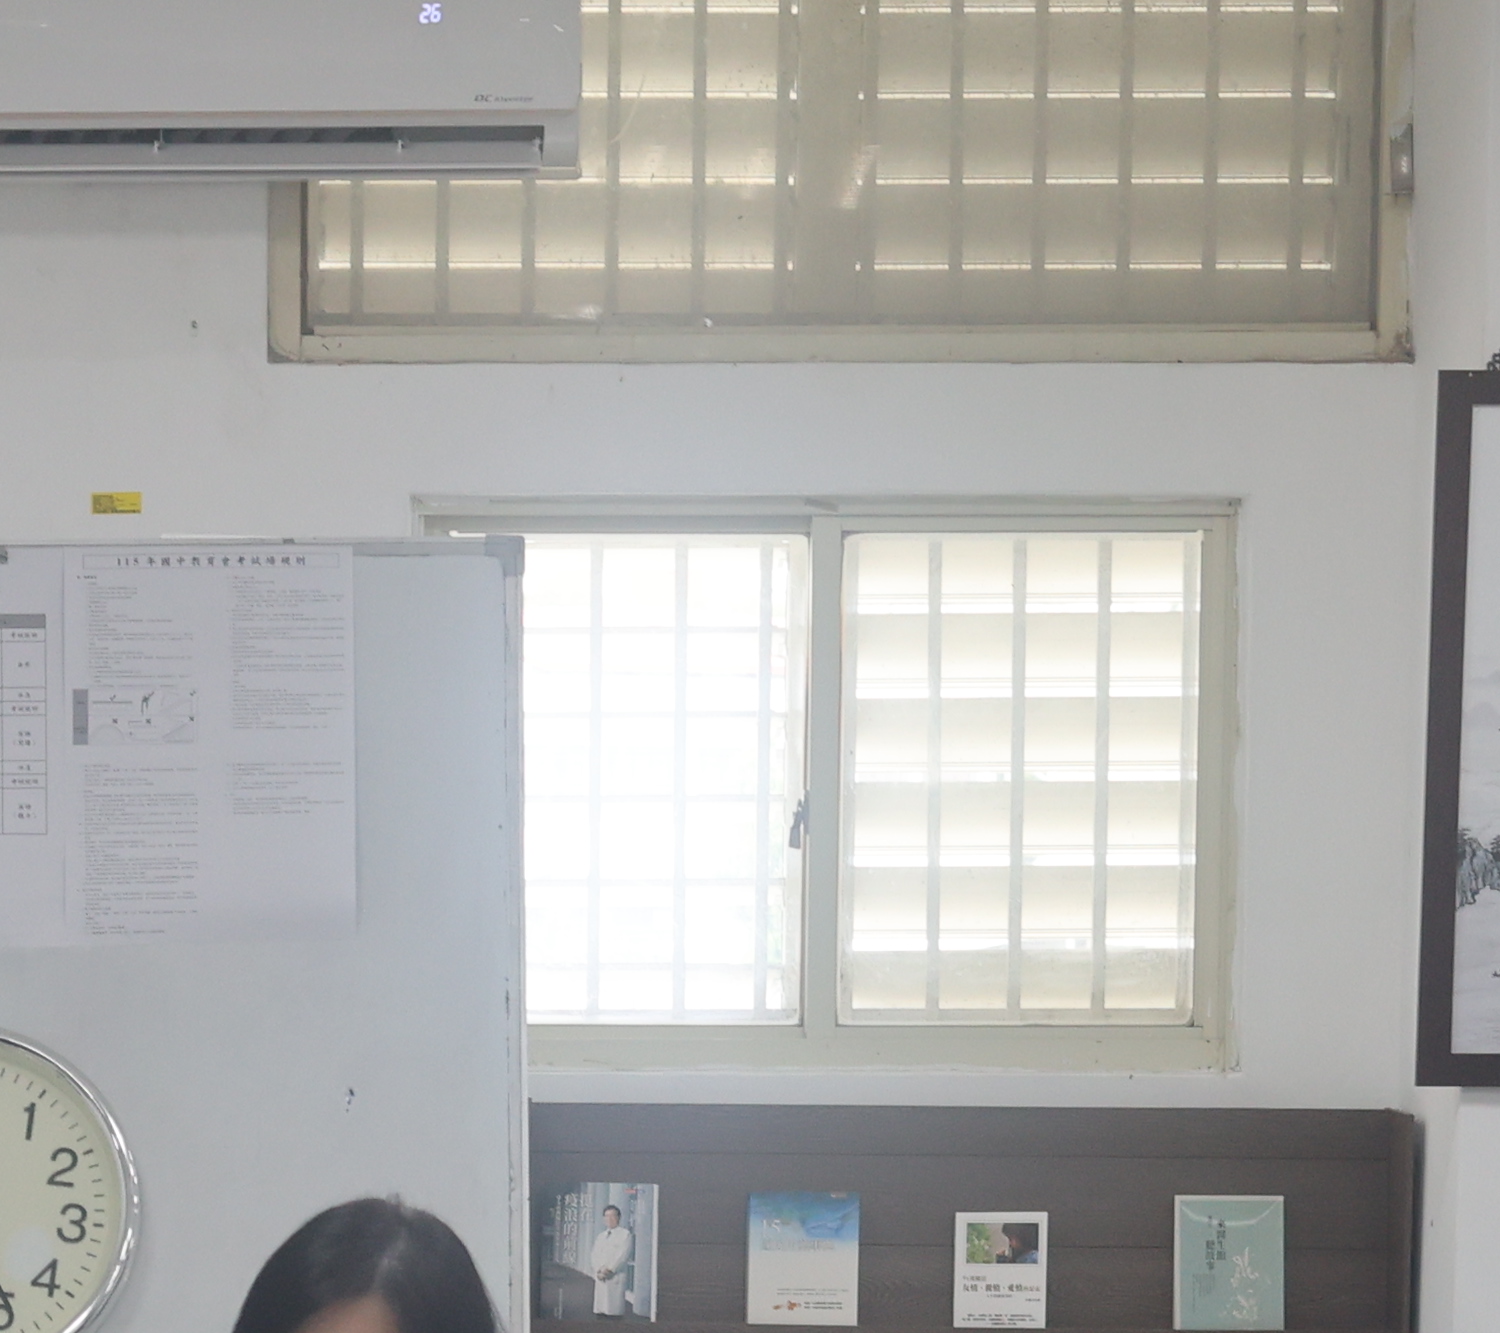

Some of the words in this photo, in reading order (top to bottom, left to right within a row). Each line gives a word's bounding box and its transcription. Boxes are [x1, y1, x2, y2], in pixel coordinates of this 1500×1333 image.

[419, 3, 442, 24] 26
[23, 1102, 36, 1141] 1
[46, 1147, 79, 1188] 2
[56, 1203, 88, 1244] 3
[30, 1258, 61, 1298] 4
